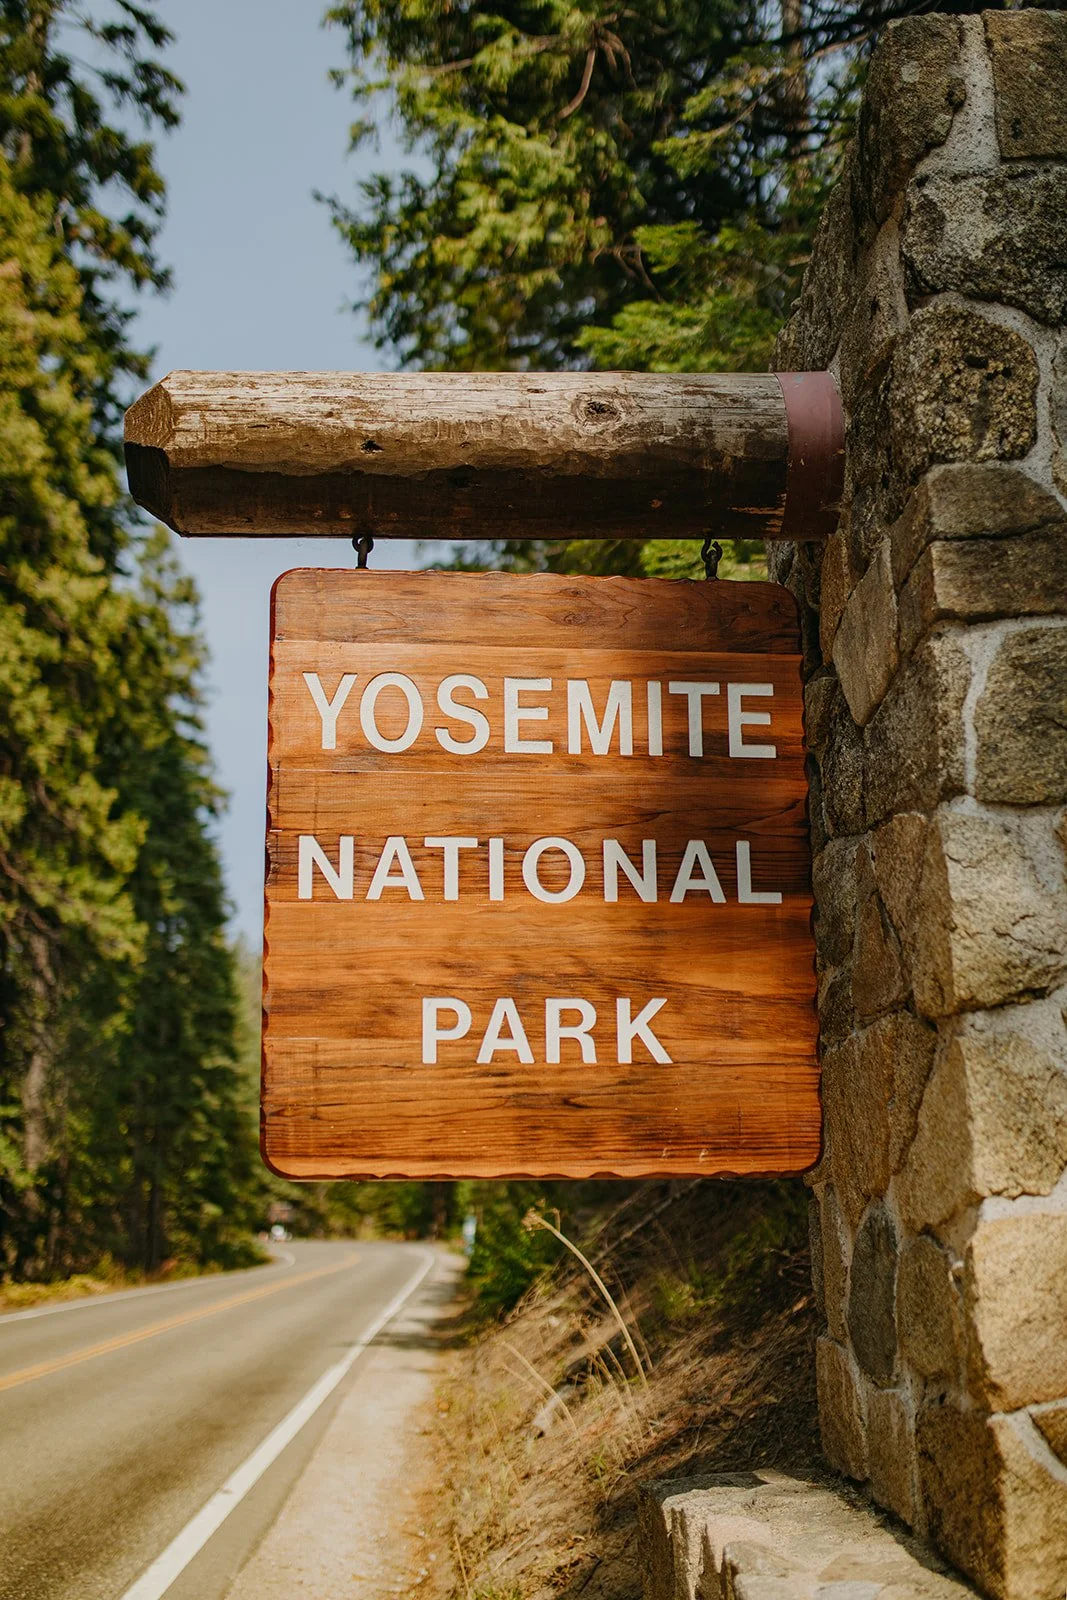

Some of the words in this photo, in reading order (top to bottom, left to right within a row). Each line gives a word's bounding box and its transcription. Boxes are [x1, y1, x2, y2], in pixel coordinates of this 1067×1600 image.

[303, 672, 777, 759] YOSEMITE
[297, 835, 783, 905] NATIONAL
[422, 997, 673, 1065] PARK
